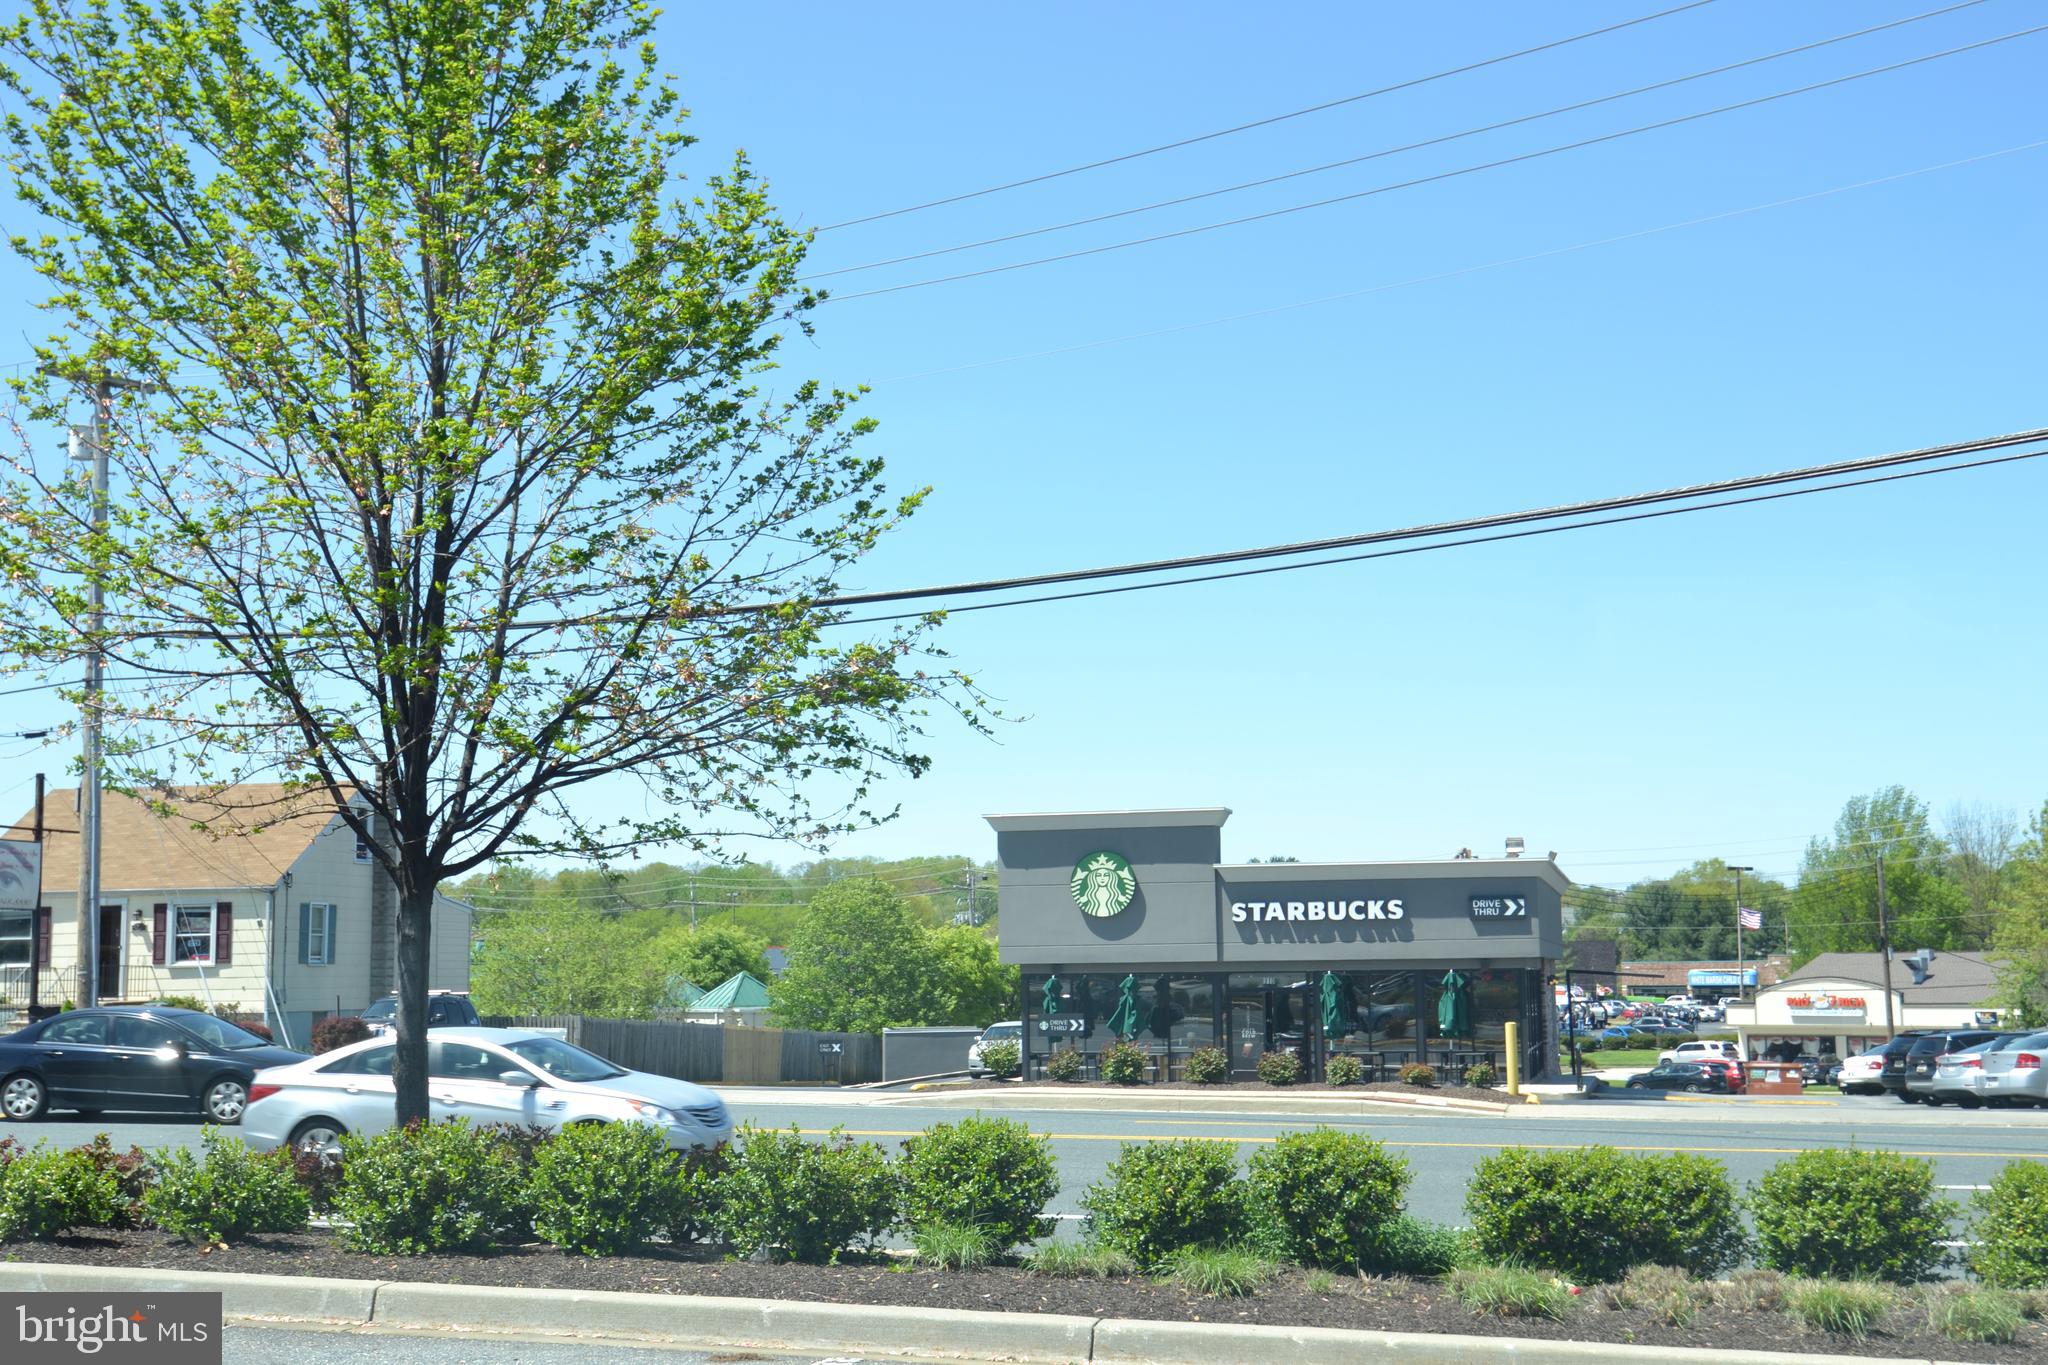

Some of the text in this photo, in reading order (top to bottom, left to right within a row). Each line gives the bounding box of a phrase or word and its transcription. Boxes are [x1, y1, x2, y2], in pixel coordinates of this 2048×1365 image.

[1472, 899, 1501, 908] DRIVE
[1231, 899, 1404, 922] STARBUCKS
[1473, 907, 1500, 916] THRU
